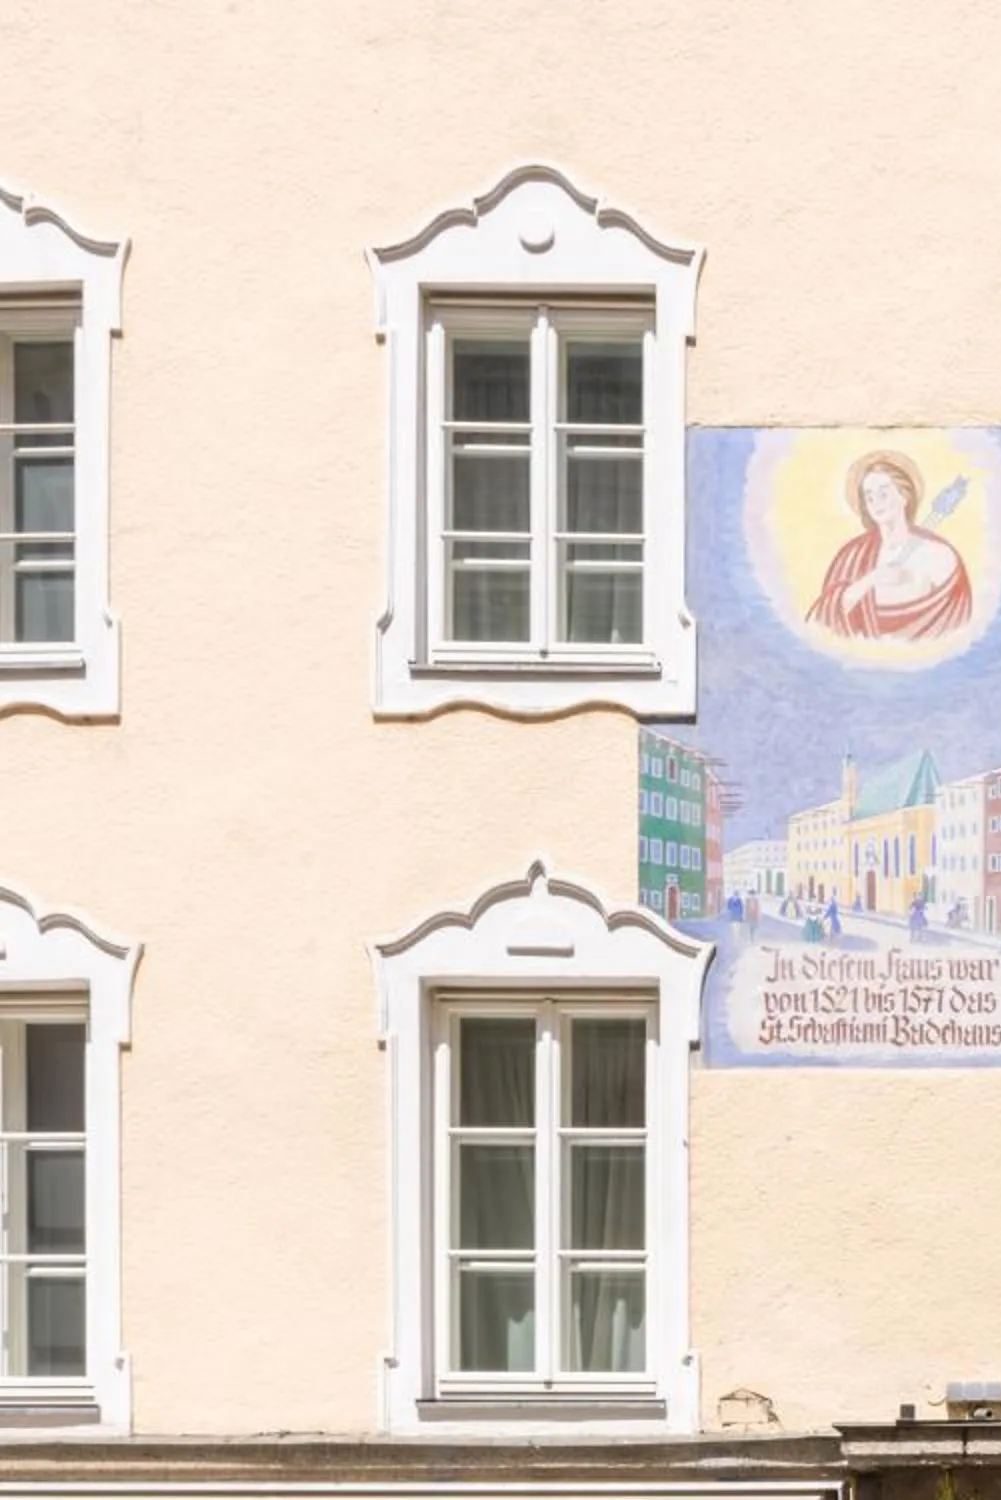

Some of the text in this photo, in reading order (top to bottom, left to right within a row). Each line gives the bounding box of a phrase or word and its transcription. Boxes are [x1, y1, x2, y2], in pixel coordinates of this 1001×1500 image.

[761, 945, 795, 982] In
[878, 947, 942, 983] Haus
[947, 958, 1000, 982] war
[763, 983, 998, 1014] von 1521 bis 1571 das
